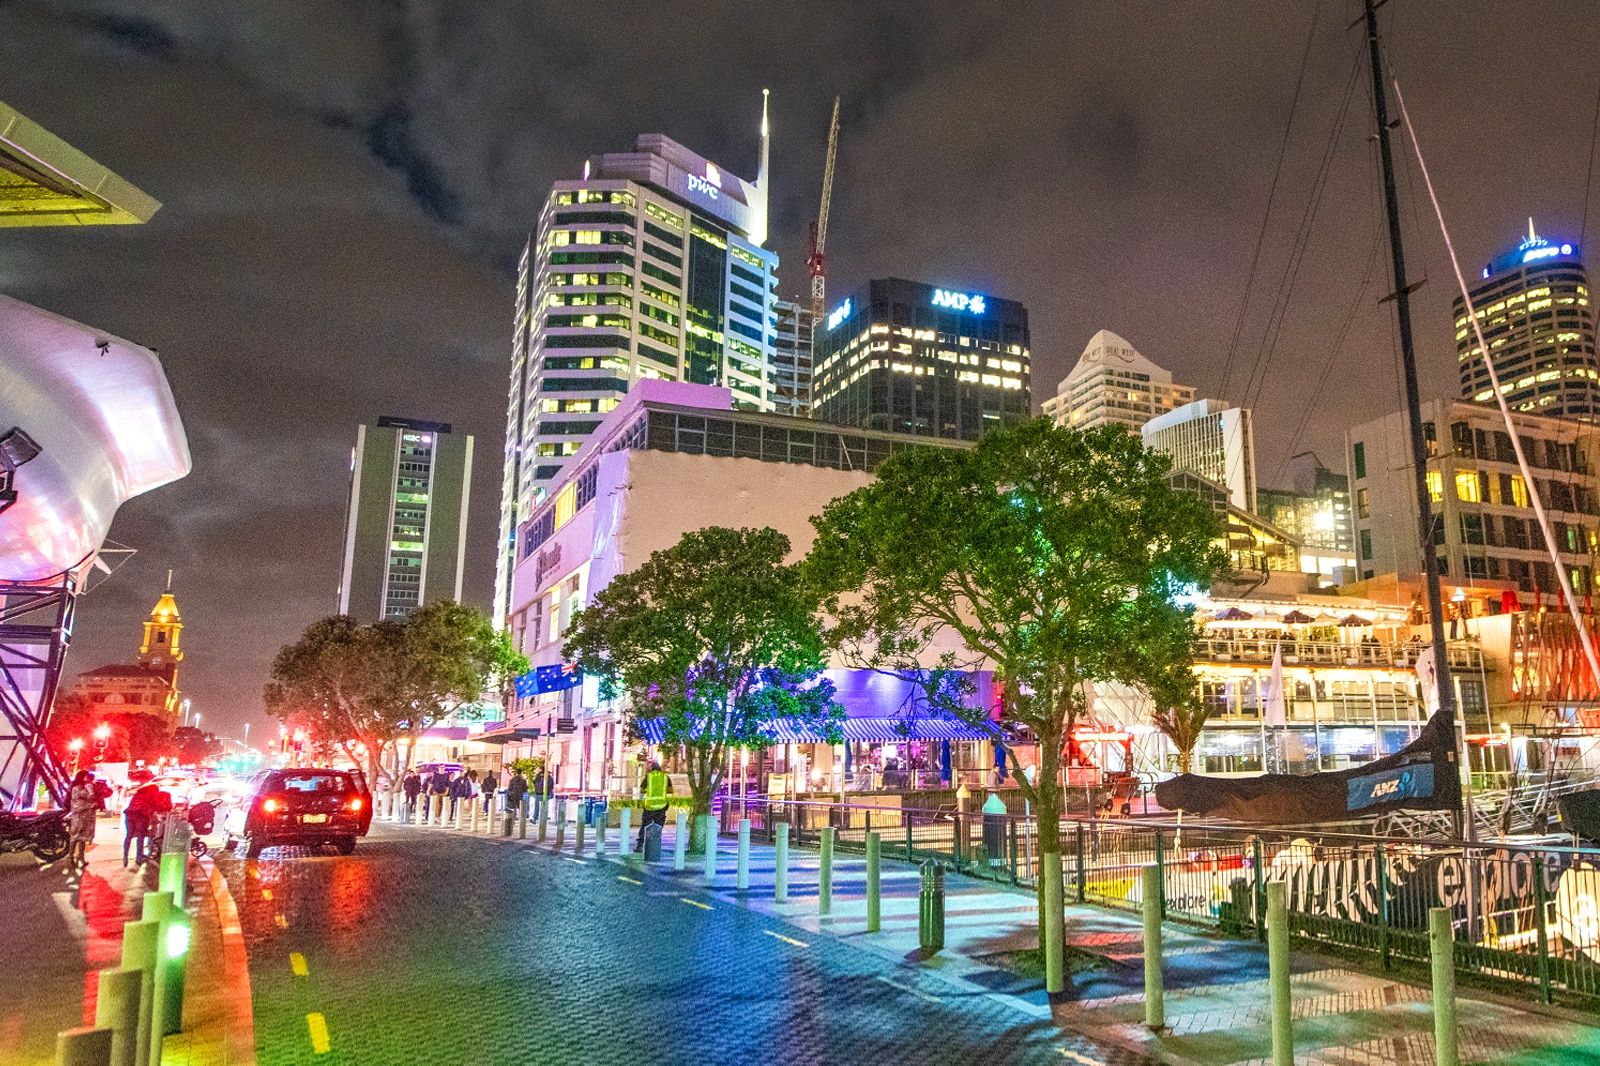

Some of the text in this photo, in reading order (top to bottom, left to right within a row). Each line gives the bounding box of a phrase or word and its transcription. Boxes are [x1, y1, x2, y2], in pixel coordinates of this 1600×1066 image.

[687, 173, 718, 199] pwc
[931, 288, 969, 311] AMP
[403, 434, 420, 442] HSBC
[1370, 779, 1400, 798] ANZ
